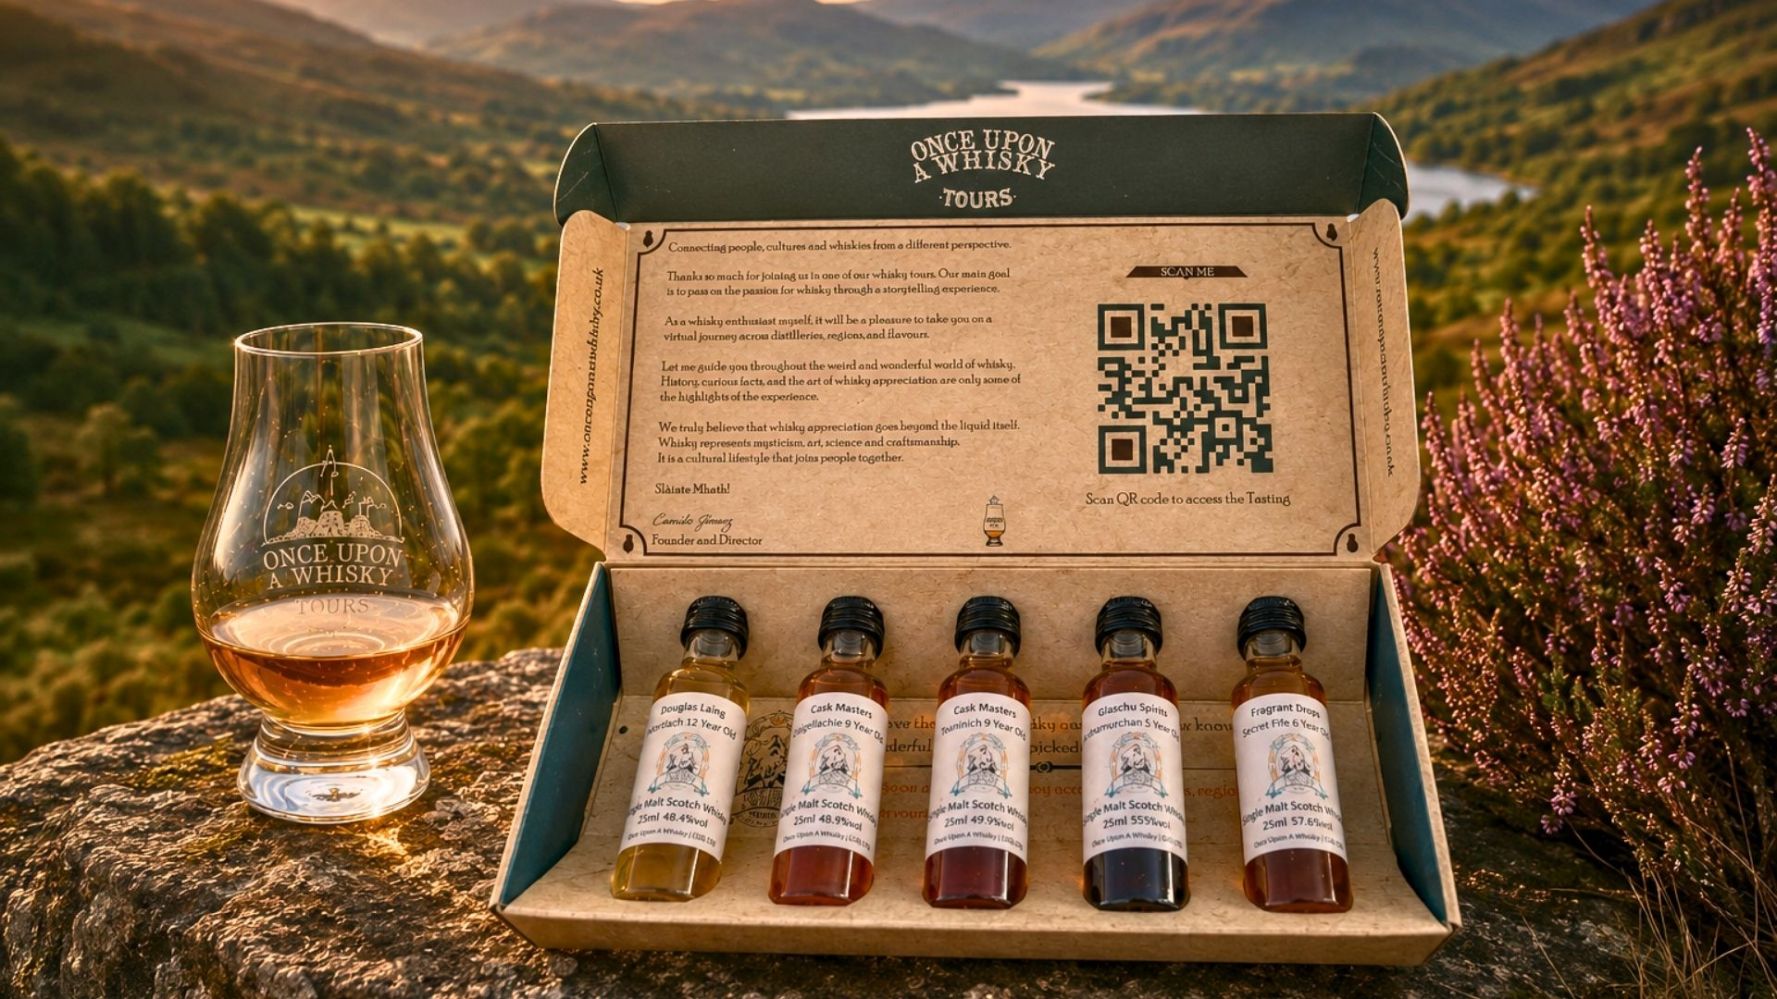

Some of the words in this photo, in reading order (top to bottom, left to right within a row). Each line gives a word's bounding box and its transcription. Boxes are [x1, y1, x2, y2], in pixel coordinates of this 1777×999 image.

[911, 130, 976, 161] ONCE
[983, 129, 1056, 159] UPON
[913, 162, 931, 183] A
[931, 150, 1056, 180] WHISKY
[943, 188, 1013, 209] TOURS
[668, 241, 727, 254] Connecting
[766, 241, 806, 251] cultures
[808, 240, 827, 251] and
[829, 240, 872, 250] whiskies
[873, 239, 896, 250] from
[905, 239, 950, 249] different
[666, 271, 703, 281] Thanks
[716, 270, 744, 281] much
[746, 270, 760, 280] for
[761, 272, 797, 282] joining
[872, 268, 907, 282] whisky
[938, 268, 959, 278] Our
[961, 270, 986, 278] main
[988, 267, 1010, 280] goal
[1161, 267, 1193, 277] SCAN
[1197, 267, 1215, 277] ME
[687, 289, 708, 298] pass
[724, 285, 741, 295] the
[742, 286, 779, 297] passion
[780, 284, 795, 295] for
[796, 284, 831, 296] whisky
[834, 283, 873, 296] through
[882, 283, 940, 296] storytelling
[688, 315, 723, 328] whisky
[725, 315, 777, 326] enthusiast
[824, 314, 844, 325] will
[868, 315, 912, 327] pleasure
[925, 313, 949, 324] take
[950, 317, 970, 326] you
[664, 330, 697, 341] virtual
[698, 332, 737, 343] journey
[866, 329, 886, 339] and
[661, 361, 678, 373] Let
[698, 361, 727, 374] guide
[729, 364, 748, 374] you
[750, 360, 807, 374] throughout
[809, 360, 826, 370] the
[827, 359, 856, 370] weird
[858, 358, 878, 370] and
[879, 358, 932, 371] wonderful
[934, 358, 963, 369] world
[702, 377, 738, 387] curious
[765, 375, 786, 386] and
[788, 375, 805, 386] the
[806, 377, 822, 386] art
[834, 374, 870, 388] whisky
[872, 376, 938, 387] appreciation
[940, 376, 957, 384] are
[959, 373, 981, 387] only
[660, 390, 677, 402] the
[678, 390, 729, 404] highlights
[742, 390, 759, 401] the
[679, 421, 704, 435] truly
[706, 421, 745, 432] believe
[746, 421, 767, 432] that
[769, 421, 806, 435] whisky
[807, 423, 874, 434] appreciation
[875, 424, 898, 434] goes
[900, 420, 939, 434] beyond
[941, 419, 958, 430] the
[960, 419, 991, 432] liquid
[659, 437, 698, 450] Whisky
[700, 438, 752, 450] represents
[825, 438, 863, 447] science
[864, 436, 884, 447] and
[685, 452, 726, 463] cultural
[728, 452, 770, 465] lifestyle
[772, 451, 793, 463] that
[793, 454, 819, 465] joins
[820, 452, 857, 465] people
[692, 483, 730, 494] Mhath!
[1086, 492, 1114, 504] Scan
[1140, 492, 1170, 505] code
[1185, 496, 1222, 504] access
[1225, 491, 1244, 504] the
[1246, 491, 1291, 507] Tasting
[652, 534, 695, 545] Founder
[696, 534, 717, 545] and
[719, 534, 763, 546] Director
[263, 545, 328, 571] ONCE
[337, 543, 403, 568] UPON
[267, 573, 283, 589] A
[291, 565, 394, 586] WHISKY
[296, 599, 369, 615] TOURS
[660, 702, 698, 715] Douglas
[700, 703, 726, 720] Laing
[811, 702, 833, 714] Cask
[835, 703, 872, 719] Masters
[953, 703, 976, 715] Cask
[979, 703, 1016, 718] Masters
[1098, 702, 1137, 716] Glaschu
[1139, 702, 1168, 717] Spirits
[1251, 704, 1293, 717] Fragrant
[1296, 704, 1320, 718] Drops
[687, 718, 698, 727] 12
[701, 719, 722, 732] Year
[853, 720, 874, 735] Year
[993, 719, 1014, 733] Year
[1242, 721, 1269, 738] Secret
[1272, 718, 1290, 728] Fife
[1301, 719, 1319, 733] Year
[644, 797, 664, 808] Malt
[666, 797, 701, 810] Scotch
[798, 799, 819, 810] Malt
[821, 799, 855, 812] Scotch
[948, 800, 969, 811] Malt
[972, 800, 1005, 813] Scotch
[1104, 801, 1125, 813] Malt
[1129, 800, 1163, 813] Scotch
[1265, 802, 1288, 814] Malt
[1291, 801, 1323, 813] Scotch
[638, 813, 659, 825] 25ml
[794, 814, 815, 826] 25ml
[944, 815, 967, 828] 25ml
[1103, 816, 1127, 829] 25ml
[1263, 817, 1287, 830] 25ml
